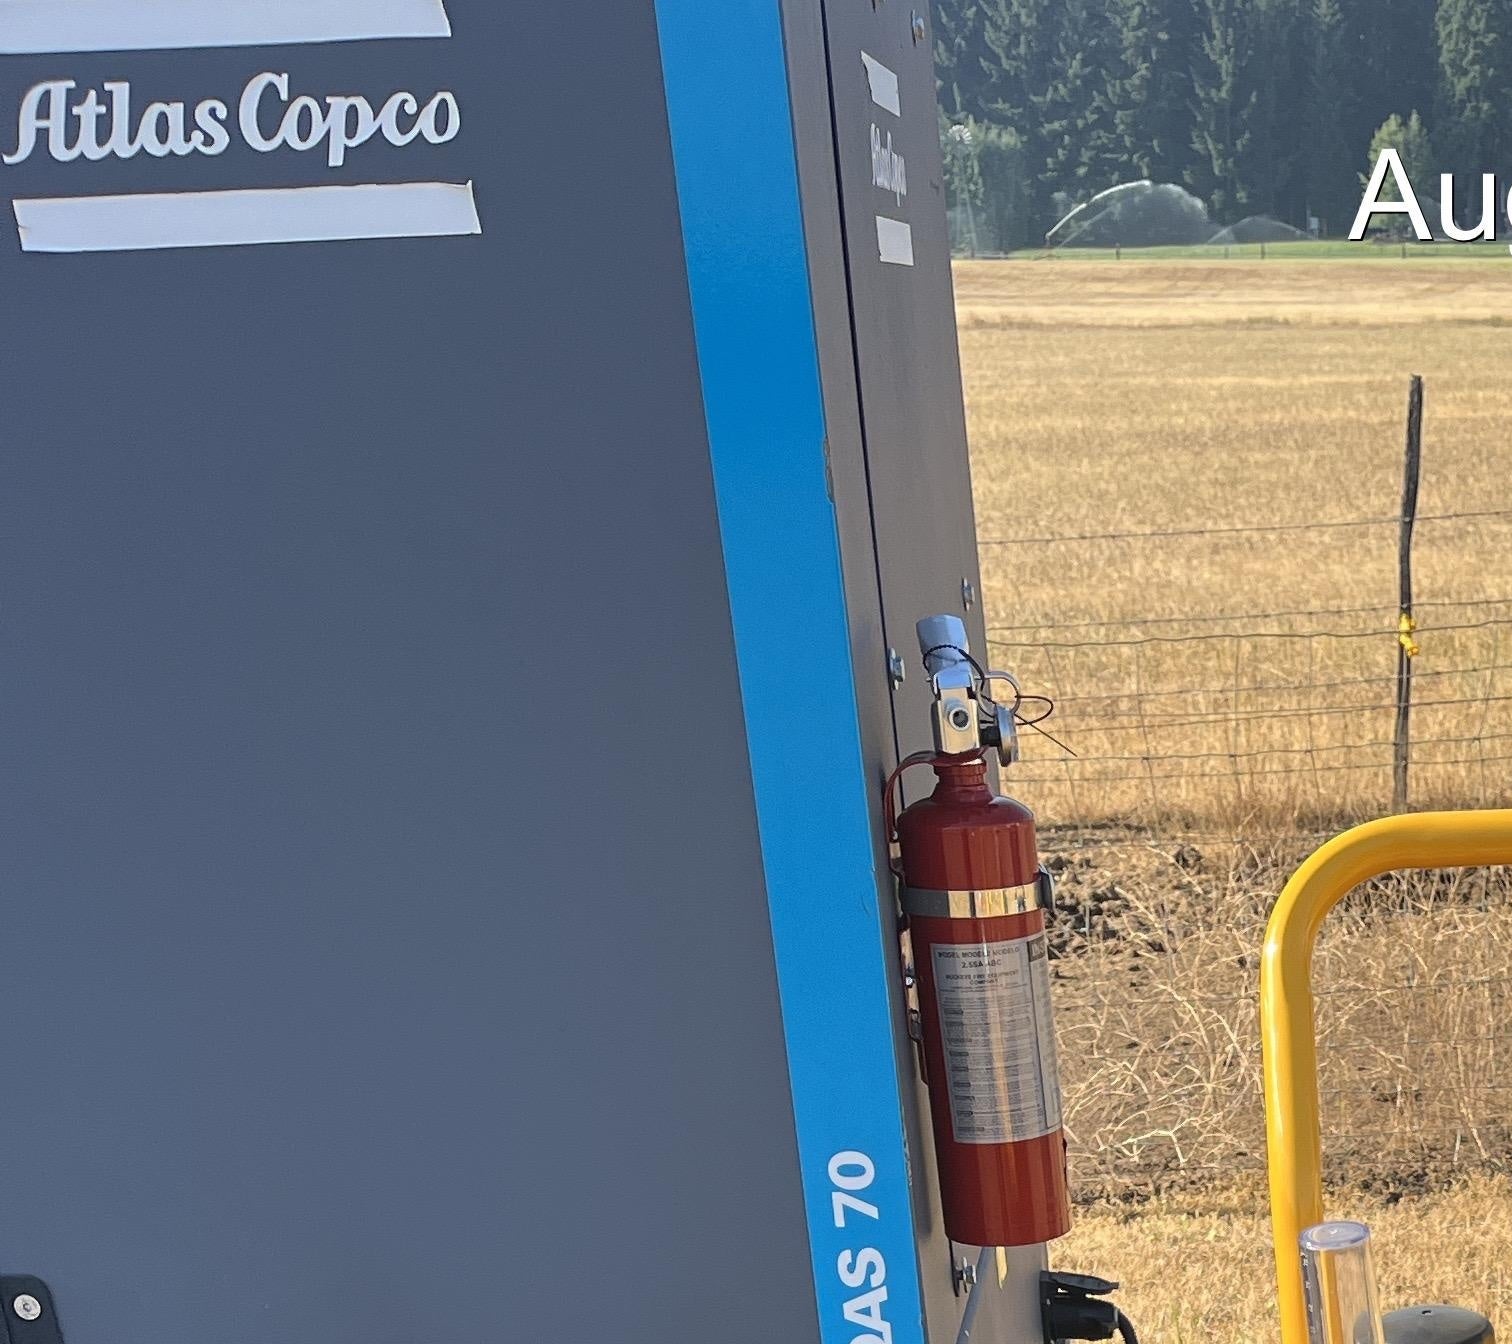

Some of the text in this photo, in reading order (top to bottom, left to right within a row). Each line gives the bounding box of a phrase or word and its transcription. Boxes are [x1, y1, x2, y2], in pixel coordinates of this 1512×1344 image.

[2, 72, 460, 167] Atlas Copco
[828, 1150, 879, 1228] 70
